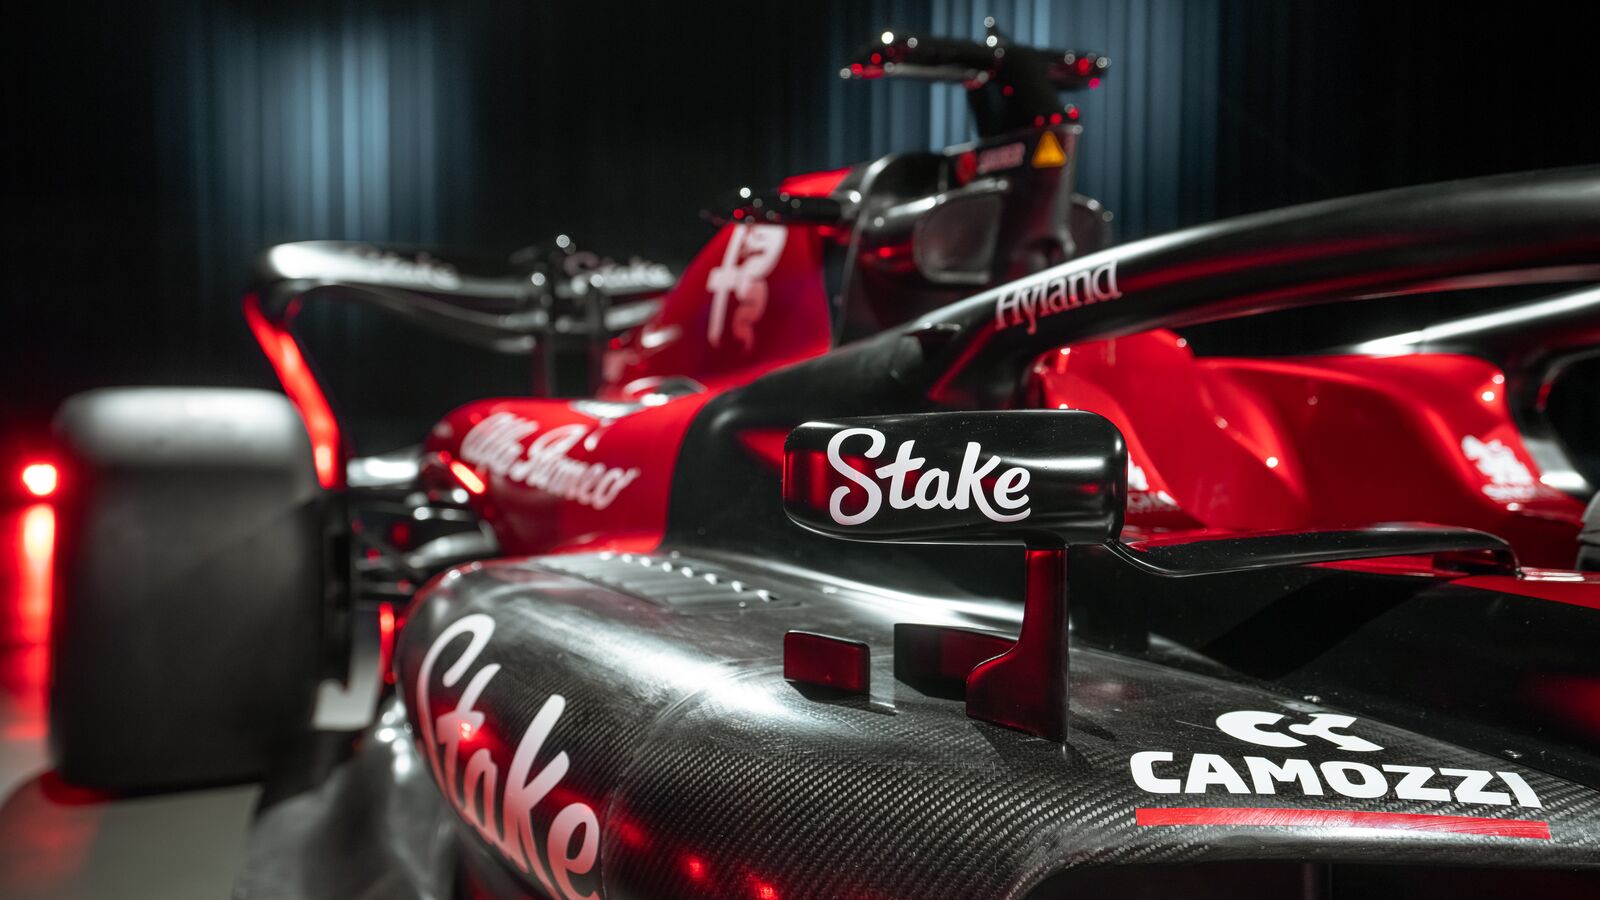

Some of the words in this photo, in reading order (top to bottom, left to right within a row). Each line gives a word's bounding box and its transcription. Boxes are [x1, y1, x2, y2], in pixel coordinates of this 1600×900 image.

[995, 260, 1122, 334] Hyland
[827, 427, 1031, 526] Stake
[416, 613, 600, 900] Stake
[1129, 750, 1543, 808] CAMOZZI
